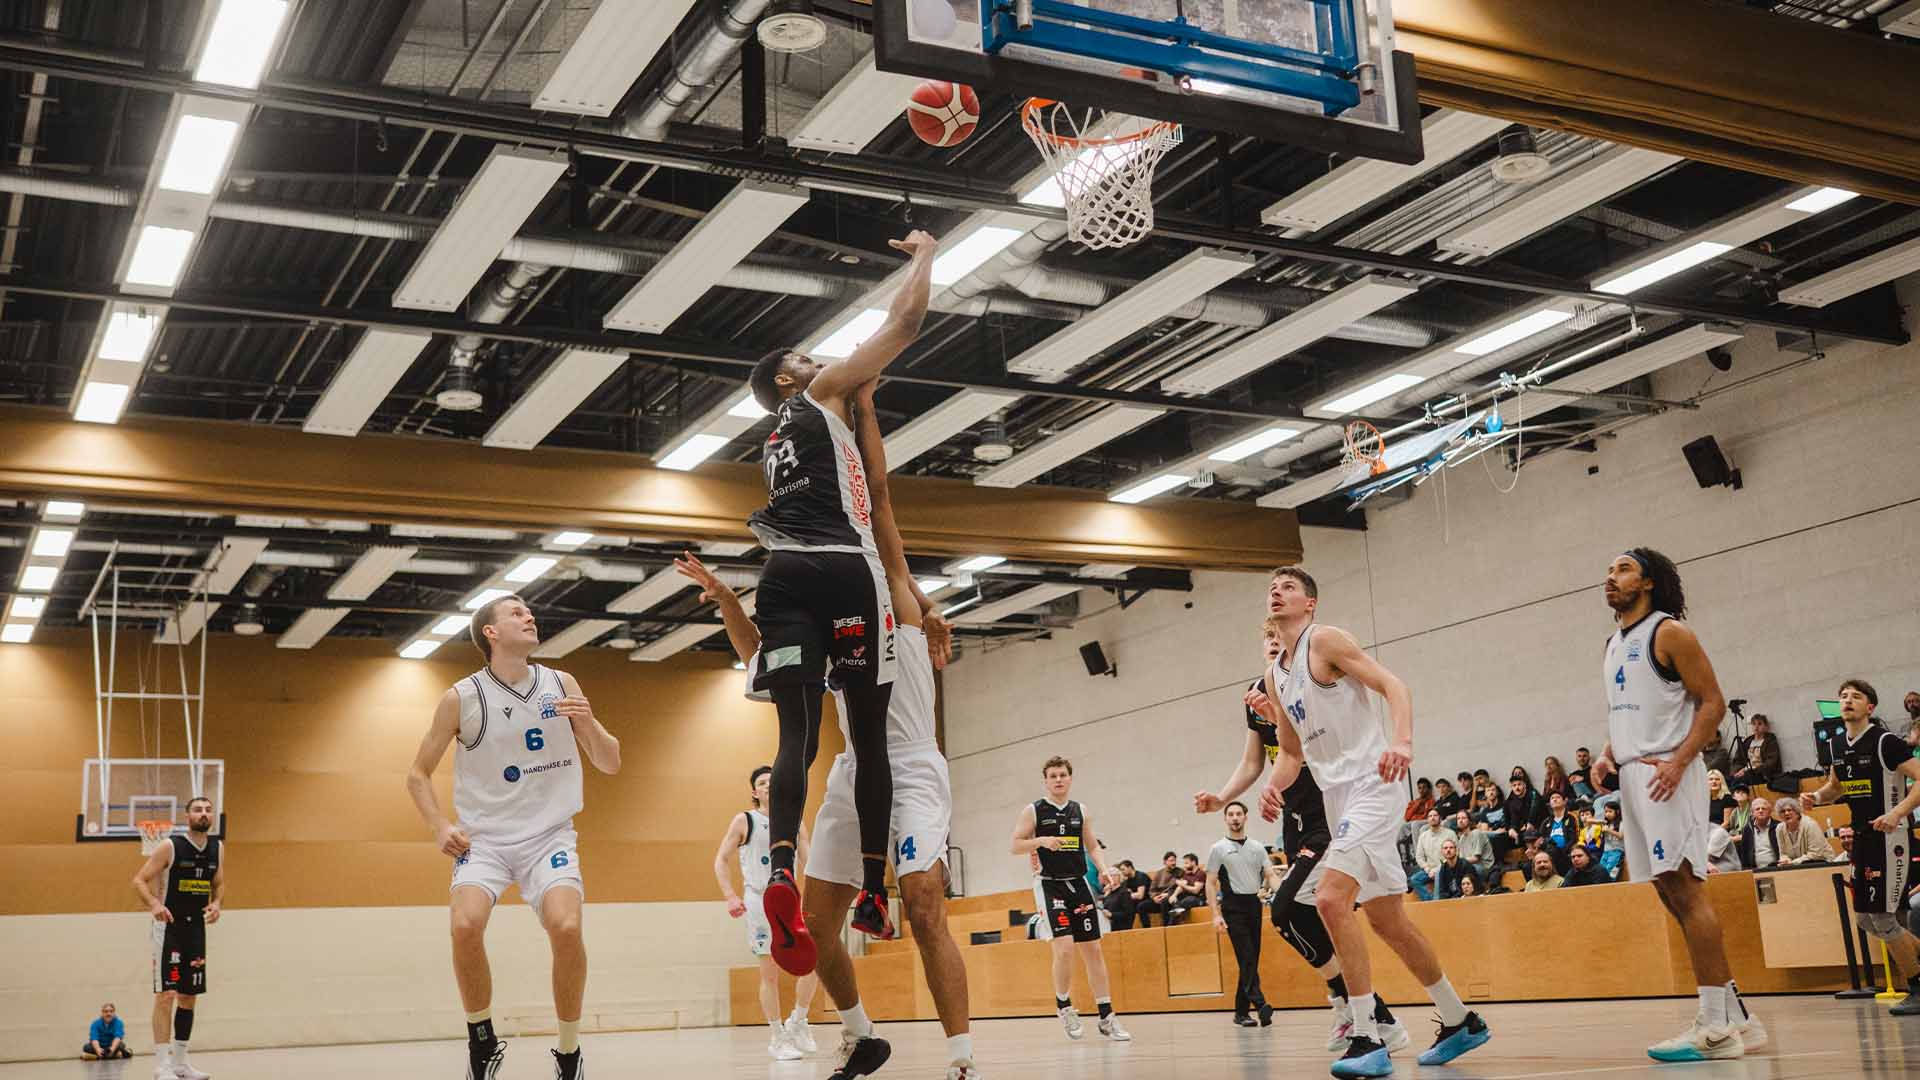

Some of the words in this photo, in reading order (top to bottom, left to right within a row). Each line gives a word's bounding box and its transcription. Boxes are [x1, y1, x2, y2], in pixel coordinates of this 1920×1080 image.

[769, 476, 810, 501] charisma
[833, 616, 866, 629] DIESEL
[1616, 665, 1627, 692] 4
[525, 728, 545, 751] 6
[1846, 765, 1853, 778] 2
[1059, 824, 1066, 836] 6
[1653, 839, 1665, 860] 4
[550, 850, 569, 869] 6
[1083, 918, 1093, 932] 6
[192, 972, 203, 986] 11
